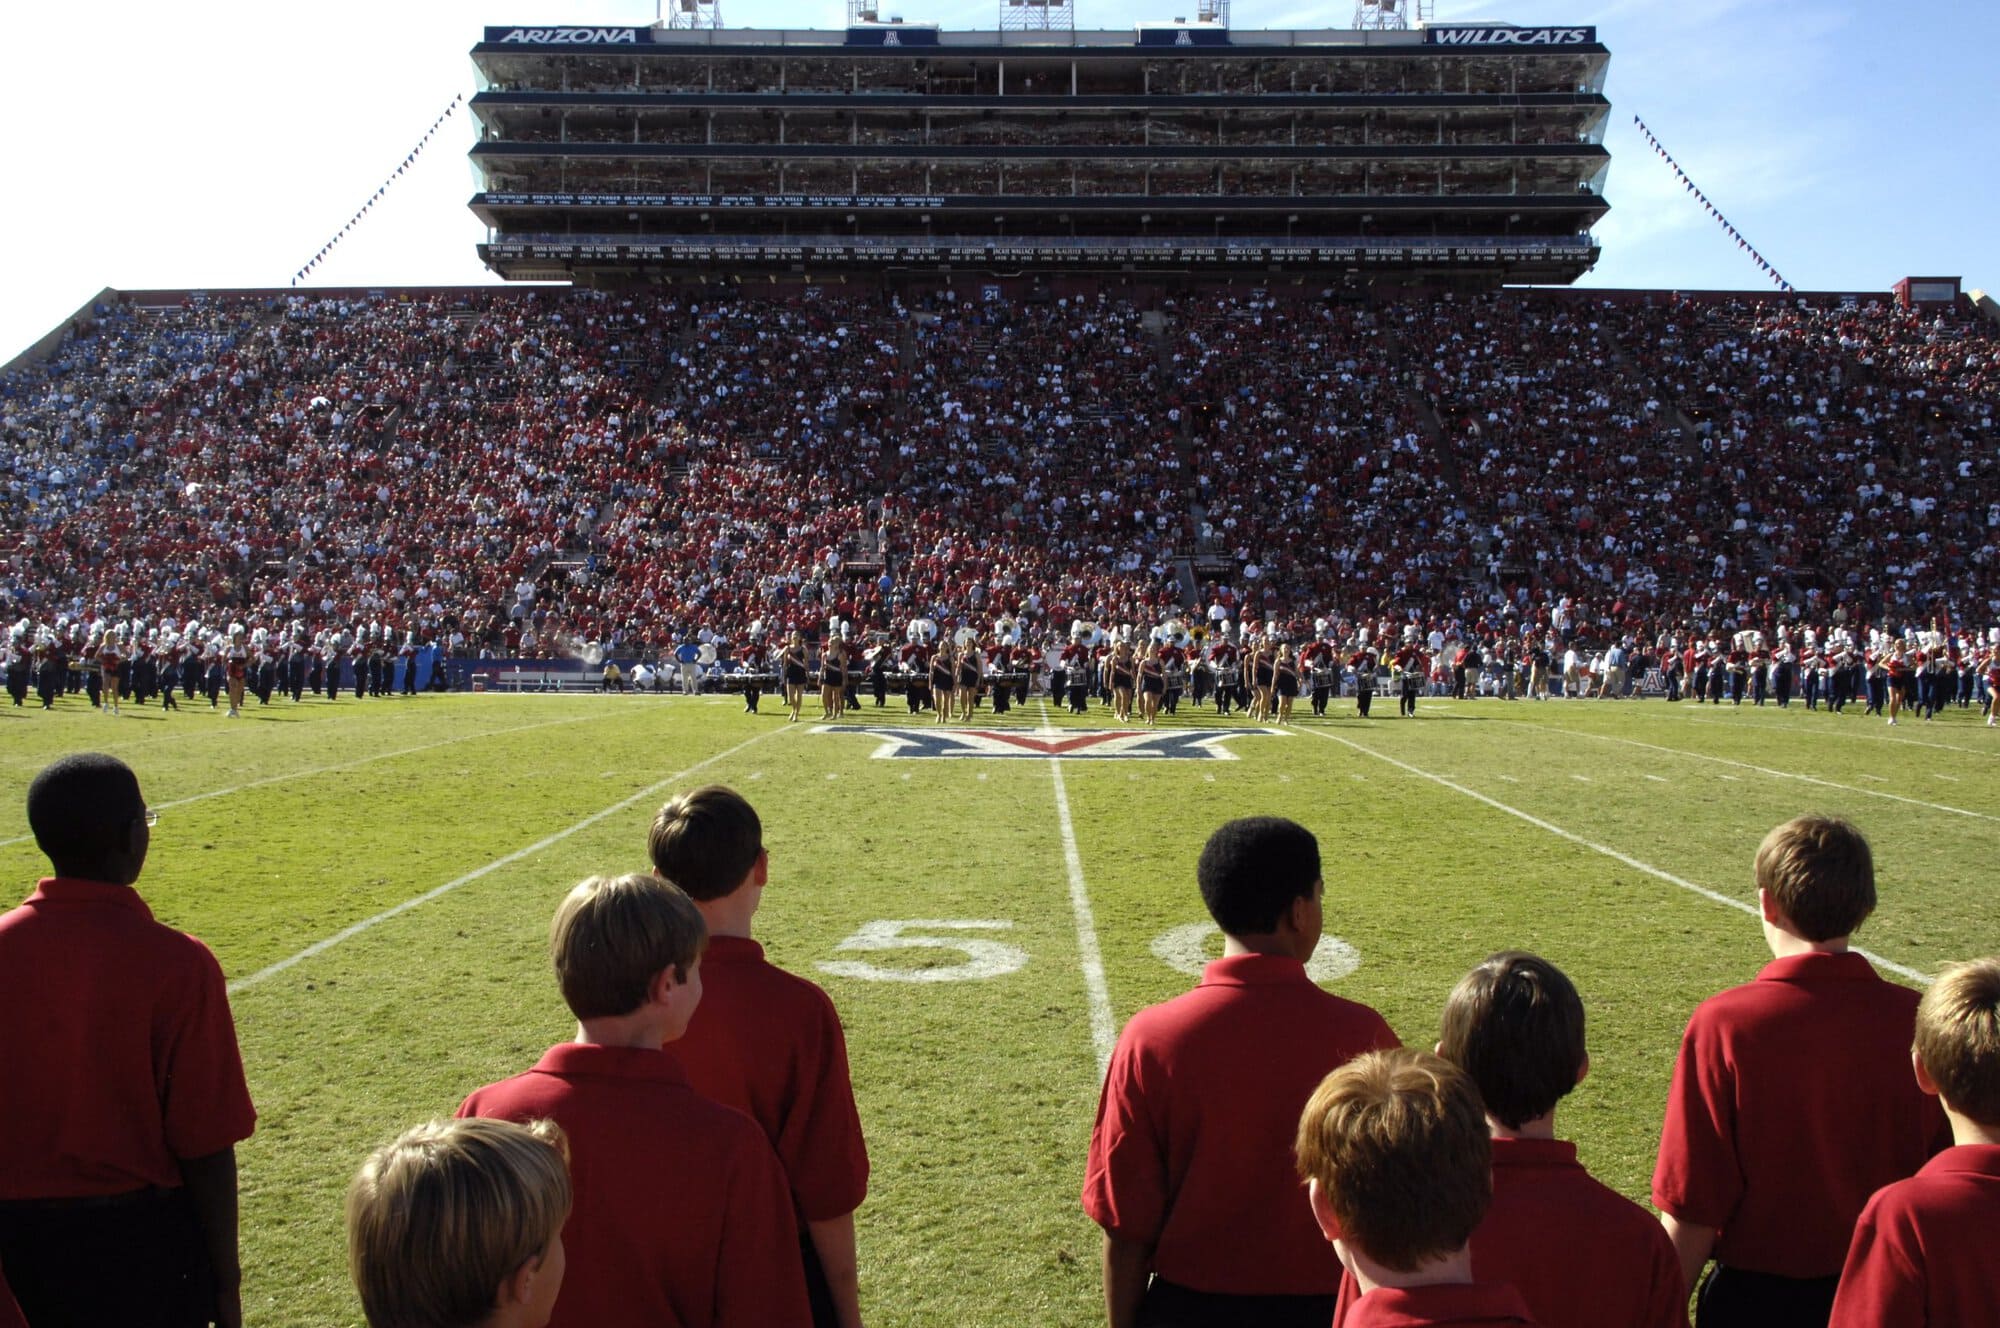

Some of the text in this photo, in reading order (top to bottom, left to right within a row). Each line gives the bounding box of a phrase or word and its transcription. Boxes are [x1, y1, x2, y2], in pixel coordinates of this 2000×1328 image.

[500, 29, 636, 43] ARIZONA
[1435, 29, 1586, 44] WILDCATS
[985, 290, 998, 300] 21
